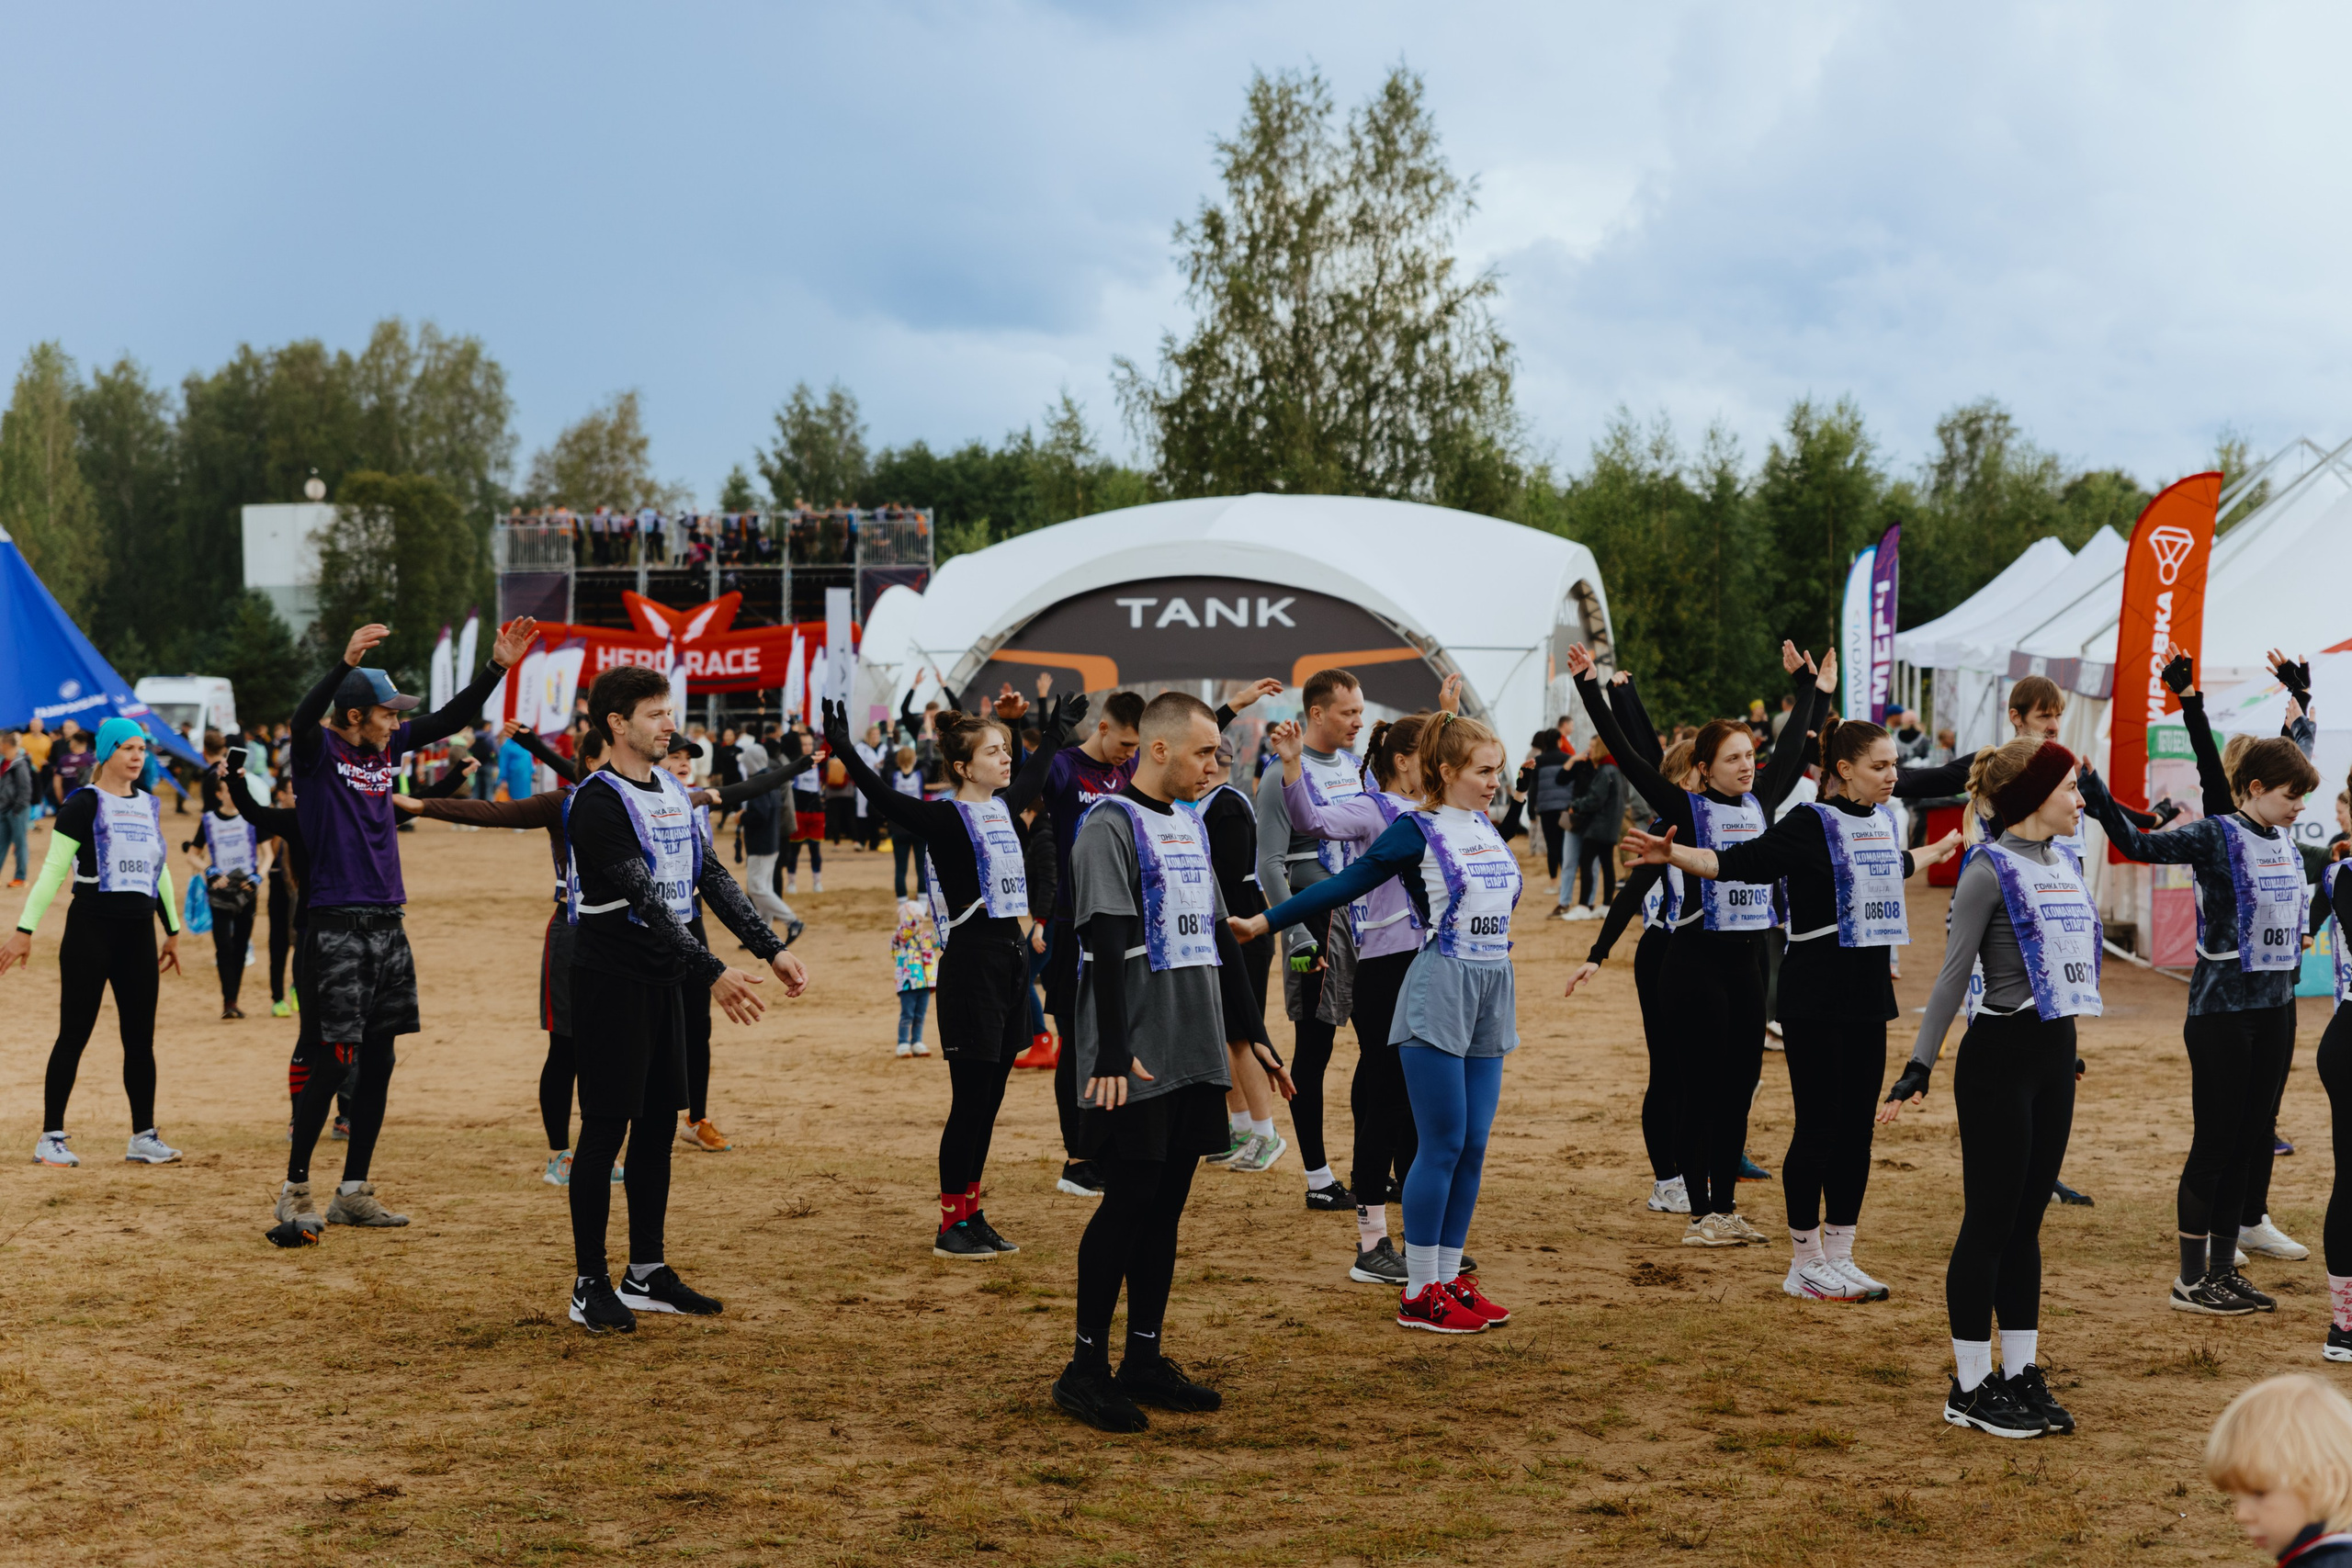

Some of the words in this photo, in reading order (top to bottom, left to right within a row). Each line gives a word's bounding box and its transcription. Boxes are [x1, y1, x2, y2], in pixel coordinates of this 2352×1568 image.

[1114, 597, 1296, 628] TANK
[1872, 580, 1891, 705] МЕРЧ
[684, 647, 762, 677] RACE
[1459, 844, 1484, 854] ГОНКА
[1469, 863, 1514, 877] КОМАНДНЫЙ
[1871, 864, 1890, 874] СТАРТ
[655, 878, 691, 900] 08601
[1485, 875, 1507, 888] СТАРТ
[1729, 888, 1768, 907] 08705
[1865, 901, 1900, 919] 08608
[1178, 914, 1211, 935] 0809
[2064, 920, 2085, 931] СТАРТ
